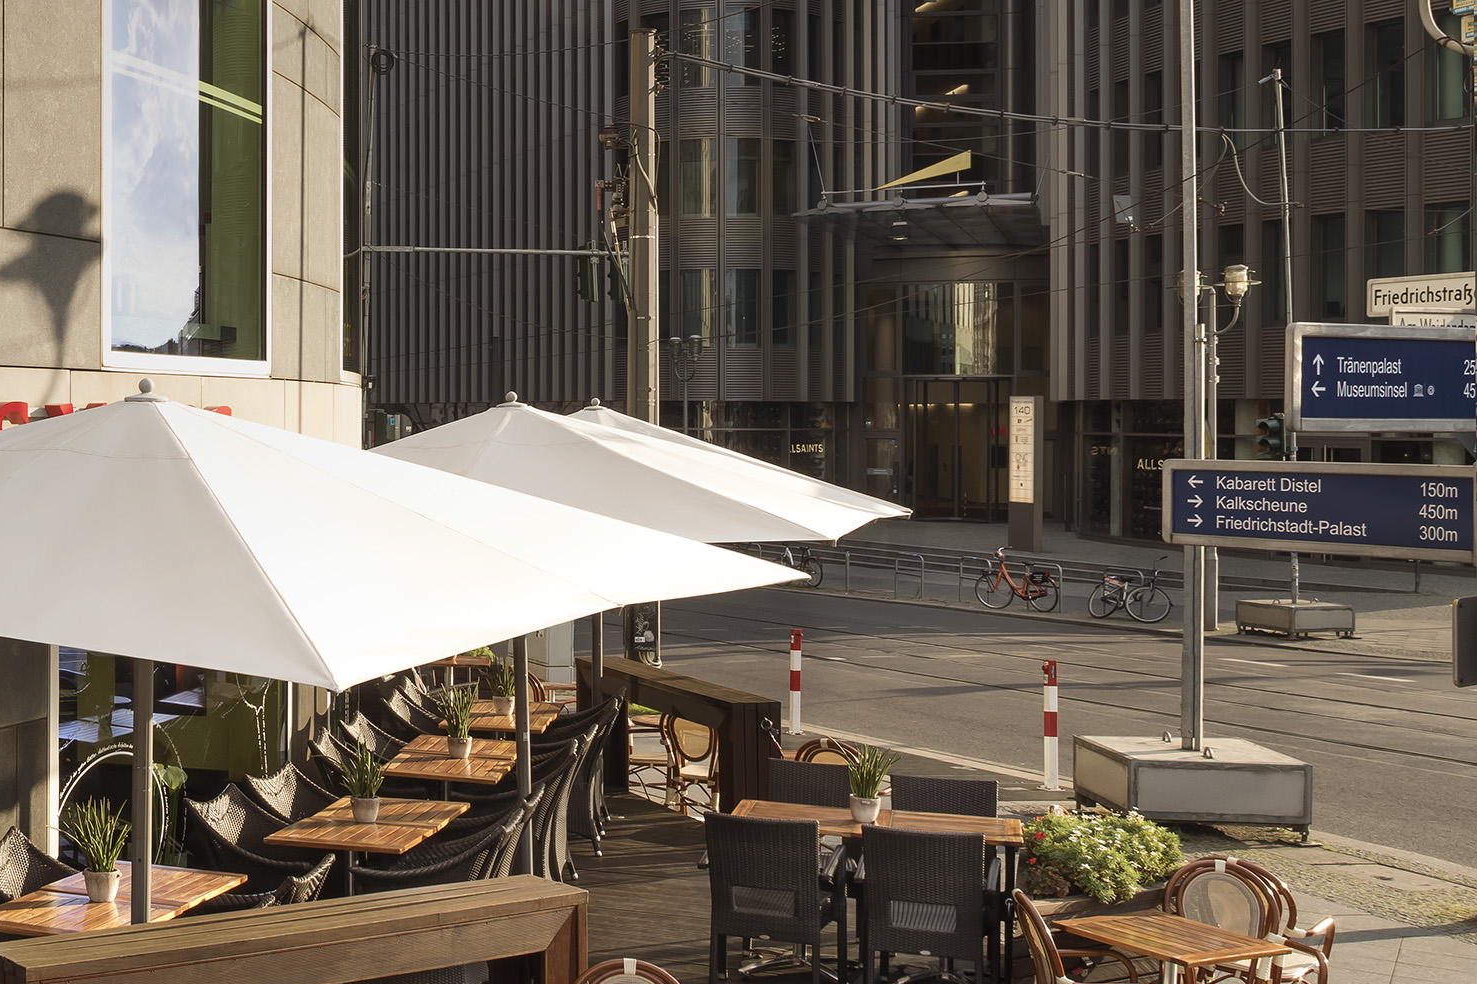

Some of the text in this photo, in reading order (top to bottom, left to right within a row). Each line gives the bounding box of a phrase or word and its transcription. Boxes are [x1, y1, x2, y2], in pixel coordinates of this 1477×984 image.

[1336, 356, 1402, 377] Tränenpalast
[1336, 381, 1408, 398] Museumsinsel
[1014, 406, 1031, 415] 140
[1215, 475, 1458, 498] Kabarett Distel 150m
[1215, 495, 1458, 520] Kalkscheune 450m
[1215, 515, 1458, 542] Friedrichstadt-Palast 300m
